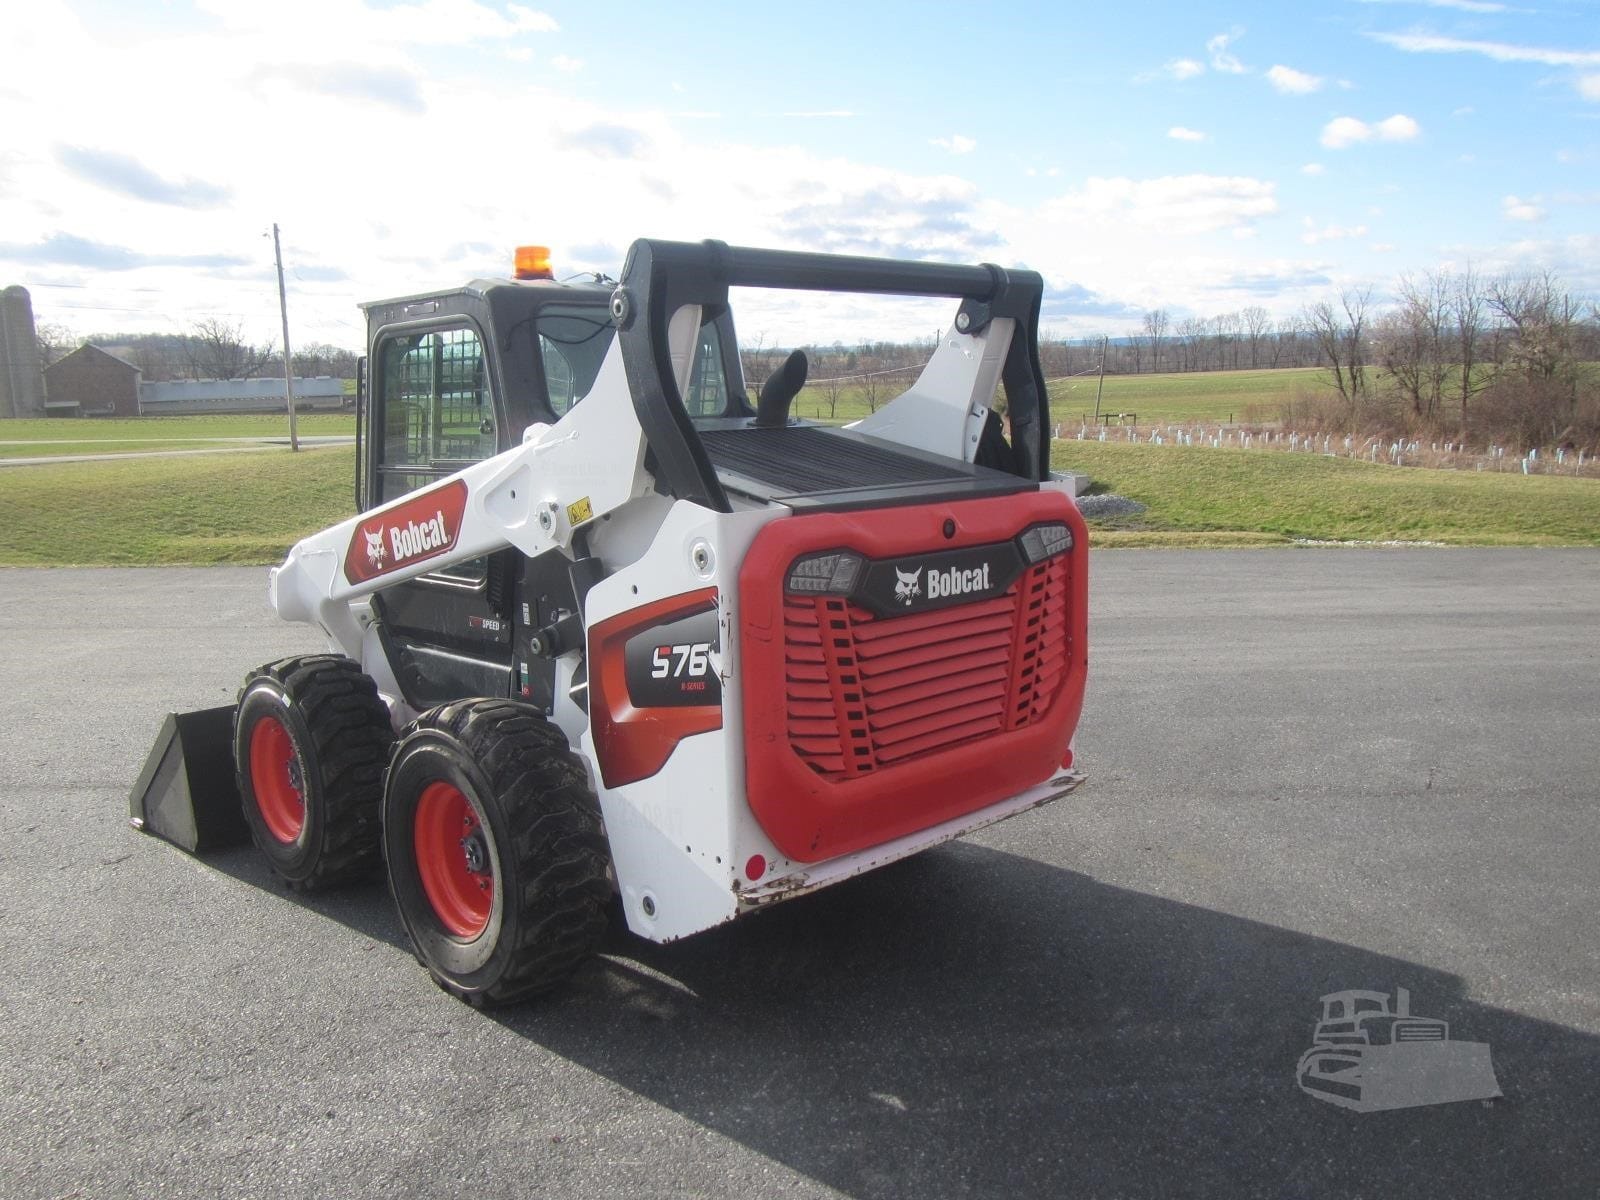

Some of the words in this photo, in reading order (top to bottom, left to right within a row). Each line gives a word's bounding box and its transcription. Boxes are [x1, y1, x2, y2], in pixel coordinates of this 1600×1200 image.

[390, 510, 448, 561] Bobcat
[928, 563, 990, 599] Bobcat
[482, 619, 500, 631] SPEED
[651, 643, 710, 679] S76
